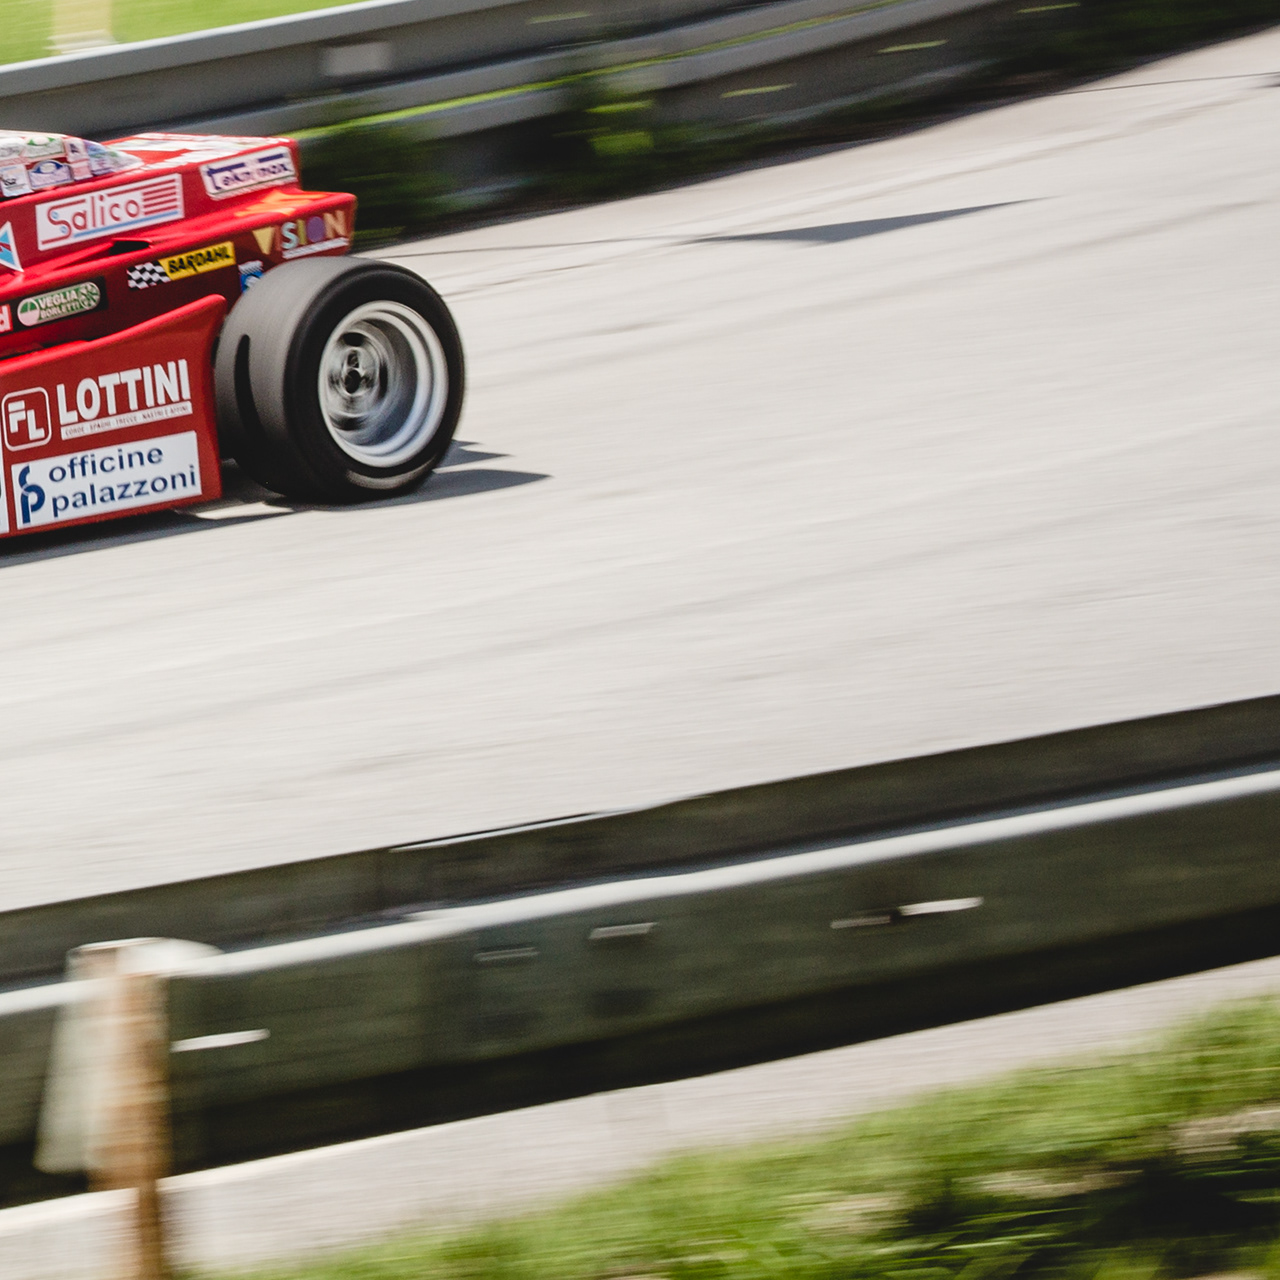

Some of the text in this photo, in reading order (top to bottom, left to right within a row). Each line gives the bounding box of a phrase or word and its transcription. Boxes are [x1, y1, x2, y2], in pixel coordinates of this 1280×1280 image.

[42, 194, 141, 246] Salico
[252, 210, 346, 255] VISION
[167, 246, 231, 274] BARDAHL
[38, 289, 78, 309] VEGLIA
[56, 359, 191, 426] LOTTINI
[8, 400, 46, 441] FL
[49, 447, 164, 483] officine
[51, 464, 197, 518] palazzoni
